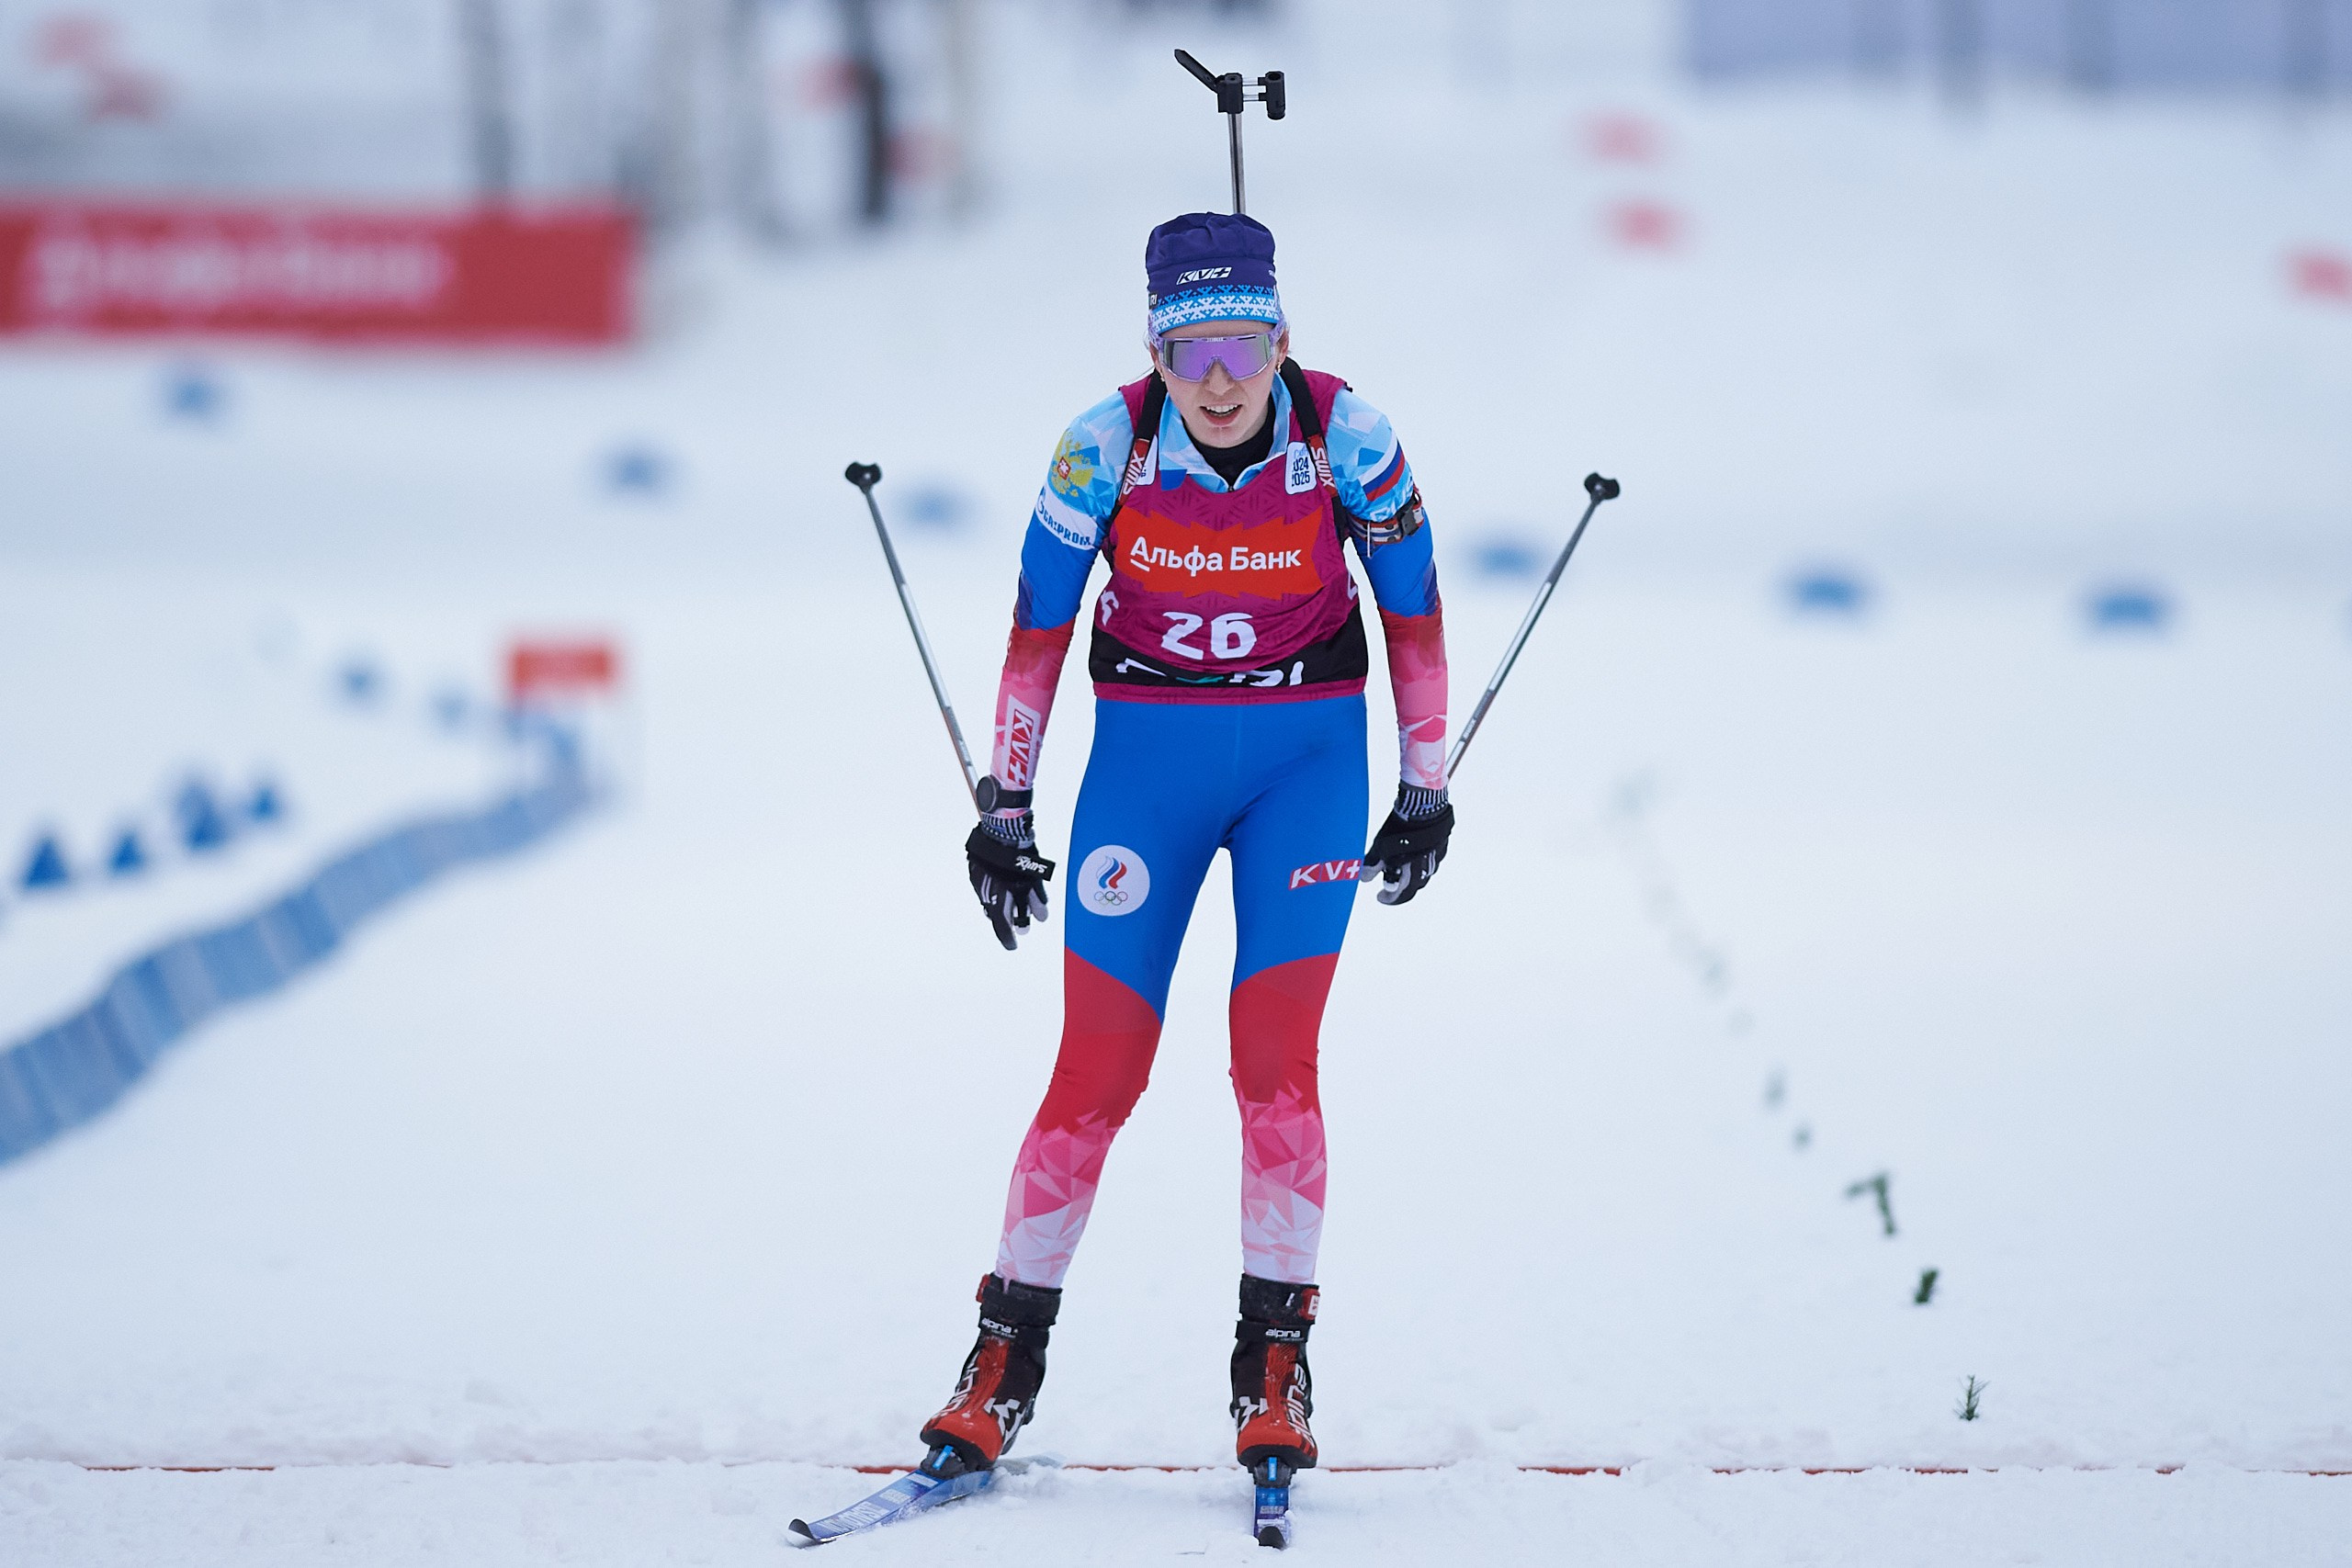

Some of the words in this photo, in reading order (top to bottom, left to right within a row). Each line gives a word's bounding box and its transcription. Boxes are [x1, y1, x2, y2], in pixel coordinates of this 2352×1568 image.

[1177, 267, 1232, 285] KV+
[1130, 536, 1224, 577] Альфа
[1230, 547, 1302, 571] Банк
[1160, 611, 1258, 660] 26
[1008, 708, 1035, 786] KV+
[1290, 860, 1362, 889] KV+
[1265, 1328, 1301, 1338] alpina
